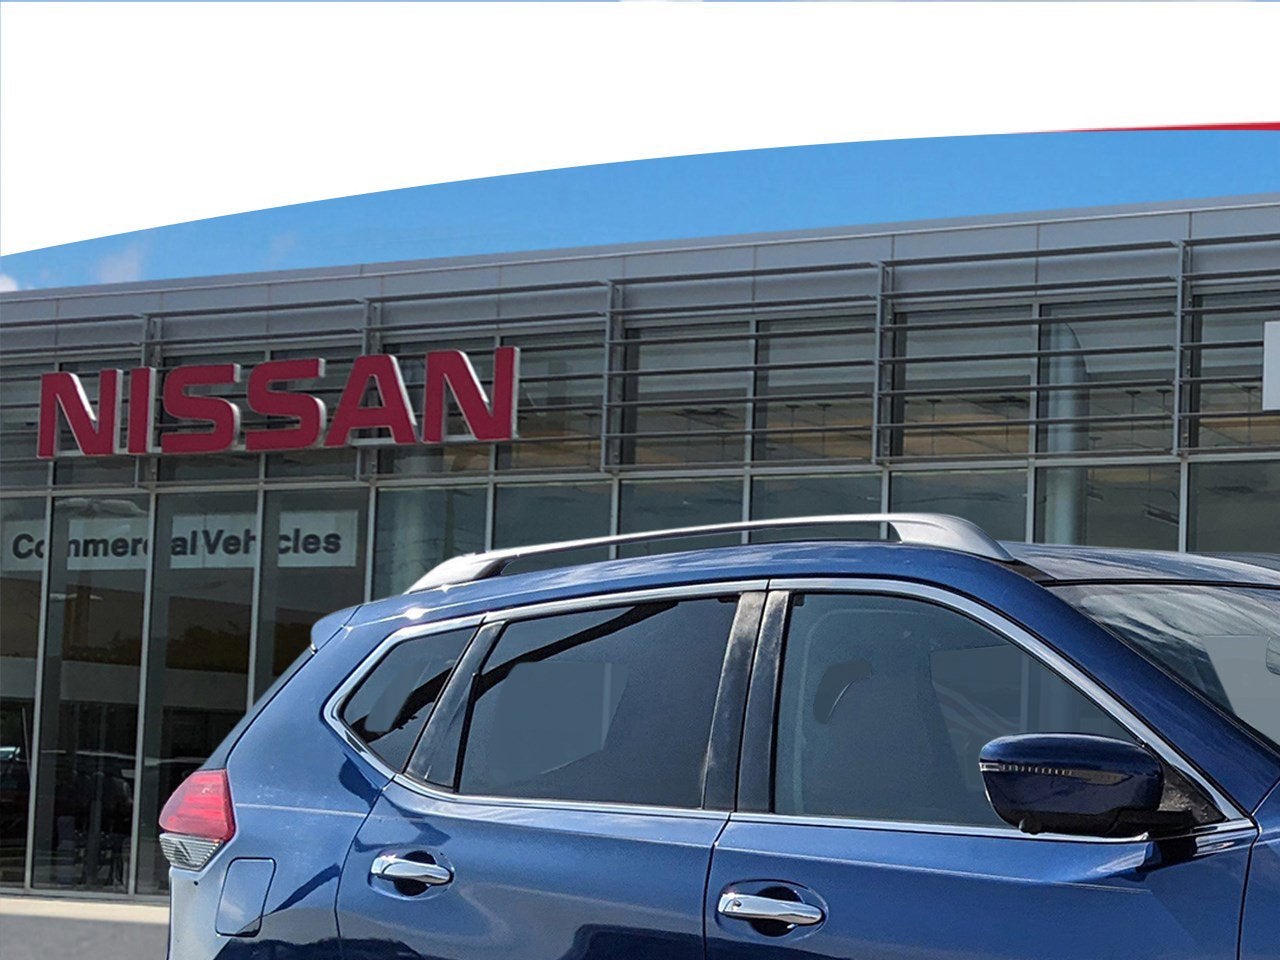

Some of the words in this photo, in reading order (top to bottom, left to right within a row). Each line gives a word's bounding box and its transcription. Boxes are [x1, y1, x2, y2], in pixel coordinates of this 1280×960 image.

[37, 346, 519, 458] NISSAN
[12, 529, 198, 560] Commeral
[202, 527, 342, 555] Vehcles
